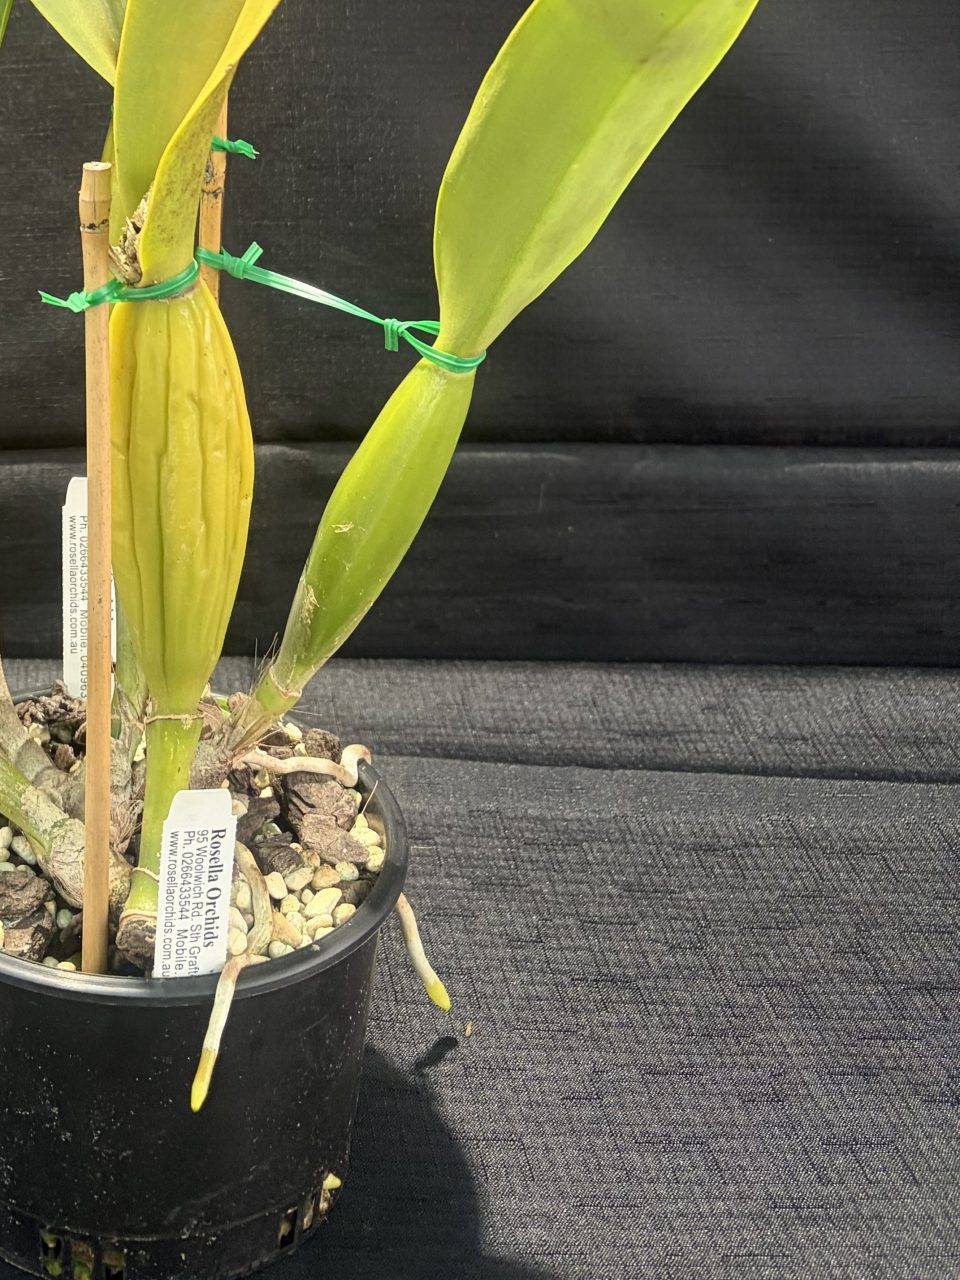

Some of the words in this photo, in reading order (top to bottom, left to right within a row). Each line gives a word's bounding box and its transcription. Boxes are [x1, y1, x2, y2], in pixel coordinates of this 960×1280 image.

[69, 515, 78, 655] www.rosellaorchids.com.au
[182, 830, 196, 849] Ph.
[196, 829, 209, 844] 95
[207, 827, 227, 883] Rosella
[178, 851, 194, 921] 0266433544
[192, 846, 207, 899] Woolwich
[162, 830, 179, 977] www.rosellaorchids.com.au
[190, 901, 203, 922] Rd.
[202, 886, 222, 948] Orchids
[189, 924, 202, 943] Sth
